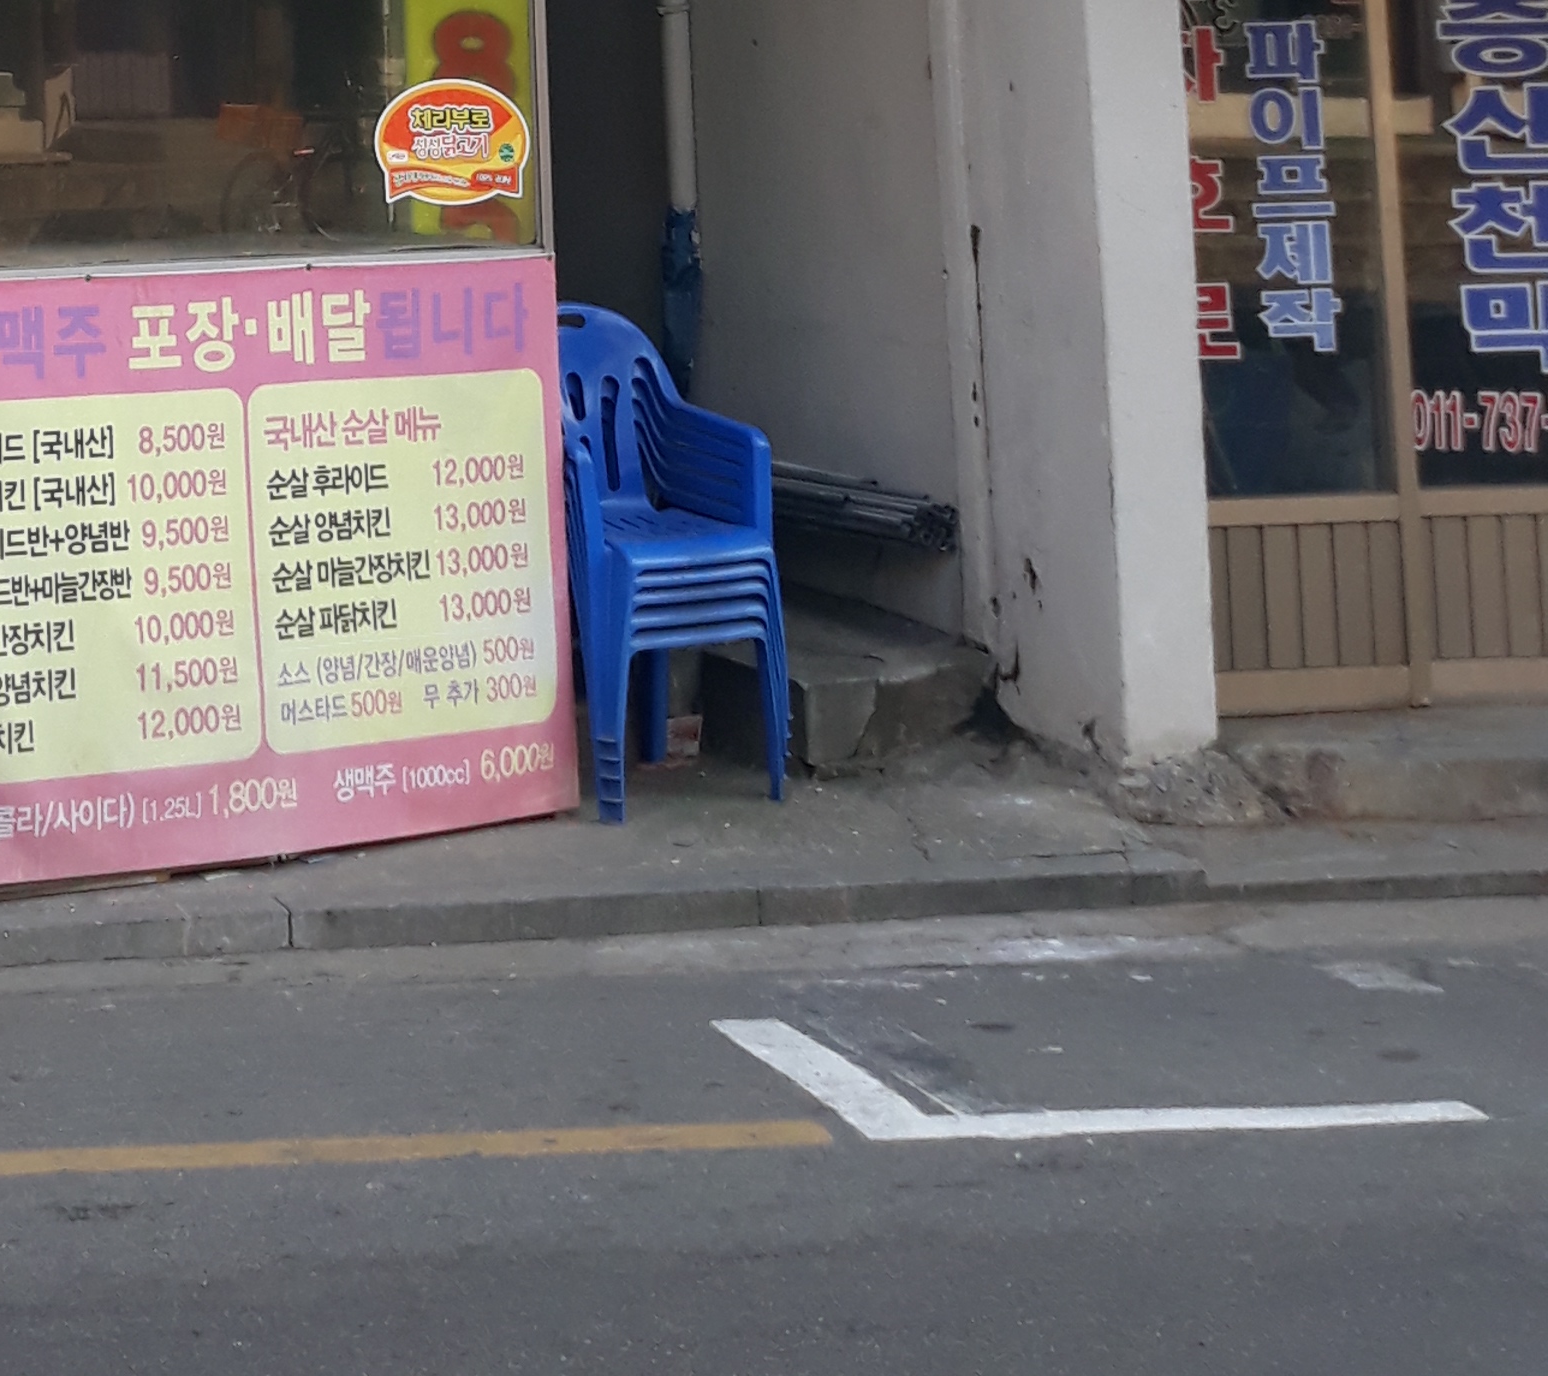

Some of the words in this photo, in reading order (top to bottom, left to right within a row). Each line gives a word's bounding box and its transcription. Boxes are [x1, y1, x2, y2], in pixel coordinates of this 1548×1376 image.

[410, 106, 491, 132] 체리부로
[1242, 18, 1344, 354] 파이프제작
[375, 282, 530, 361] 됩니다
[33, 424, 114, 464] [국내산]
[138, 422, 226, 458] 8,500원
[263, 411, 337, 451] 국내산
[341, 408, 389, 446] 순살
[394, 405, 442, 442] 메뉴
[33, 471, 115, 511] [국내산]
[126, 468, 227, 504] 10,000원
[266, 467, 309, 500] 순살
[312, 462, 389, 496] 후라이드
[431, 453, 525, 488] 12,000원
[141, 514, 230, 552] 9,500원
[268, 513, 310, 547] 순살
[314, 506, 391, 542] 양념치킨
[433, 498, 527, 532] 13,000원
[143, 562, 232, 599] 9,500원
[271, 559, 313, 594] 순살
[317, 549, 431, 588] 마늘간장치킨
[434, 542, 529, 577] 13,000원
[134, 609, 235, 645] 10,000원
[275, 607, 315, 641] 순살
[319, 598, 398, 636] 파닭치킨
[438, 587, 532, 623] 13,000원
[136, 656, 239, 693] 11,500원
[277, 661, 311, 688] 소스
[482, 635, 536, 665] 500원
[138, 703, 242, 741] 12,000원
[281, 695, 348, 726] 머스타드
[351, 690, 402, 718] 500원
[422, 683, 441, 710] 무
[446, 678, 479, 708] 추가
[486, 673, 538, 704] 300원
[333, 763, 397, 803] 생맥주
[480, 742, 554, 783] 6,000원
[209, 777, 298, 819] 1,800원
